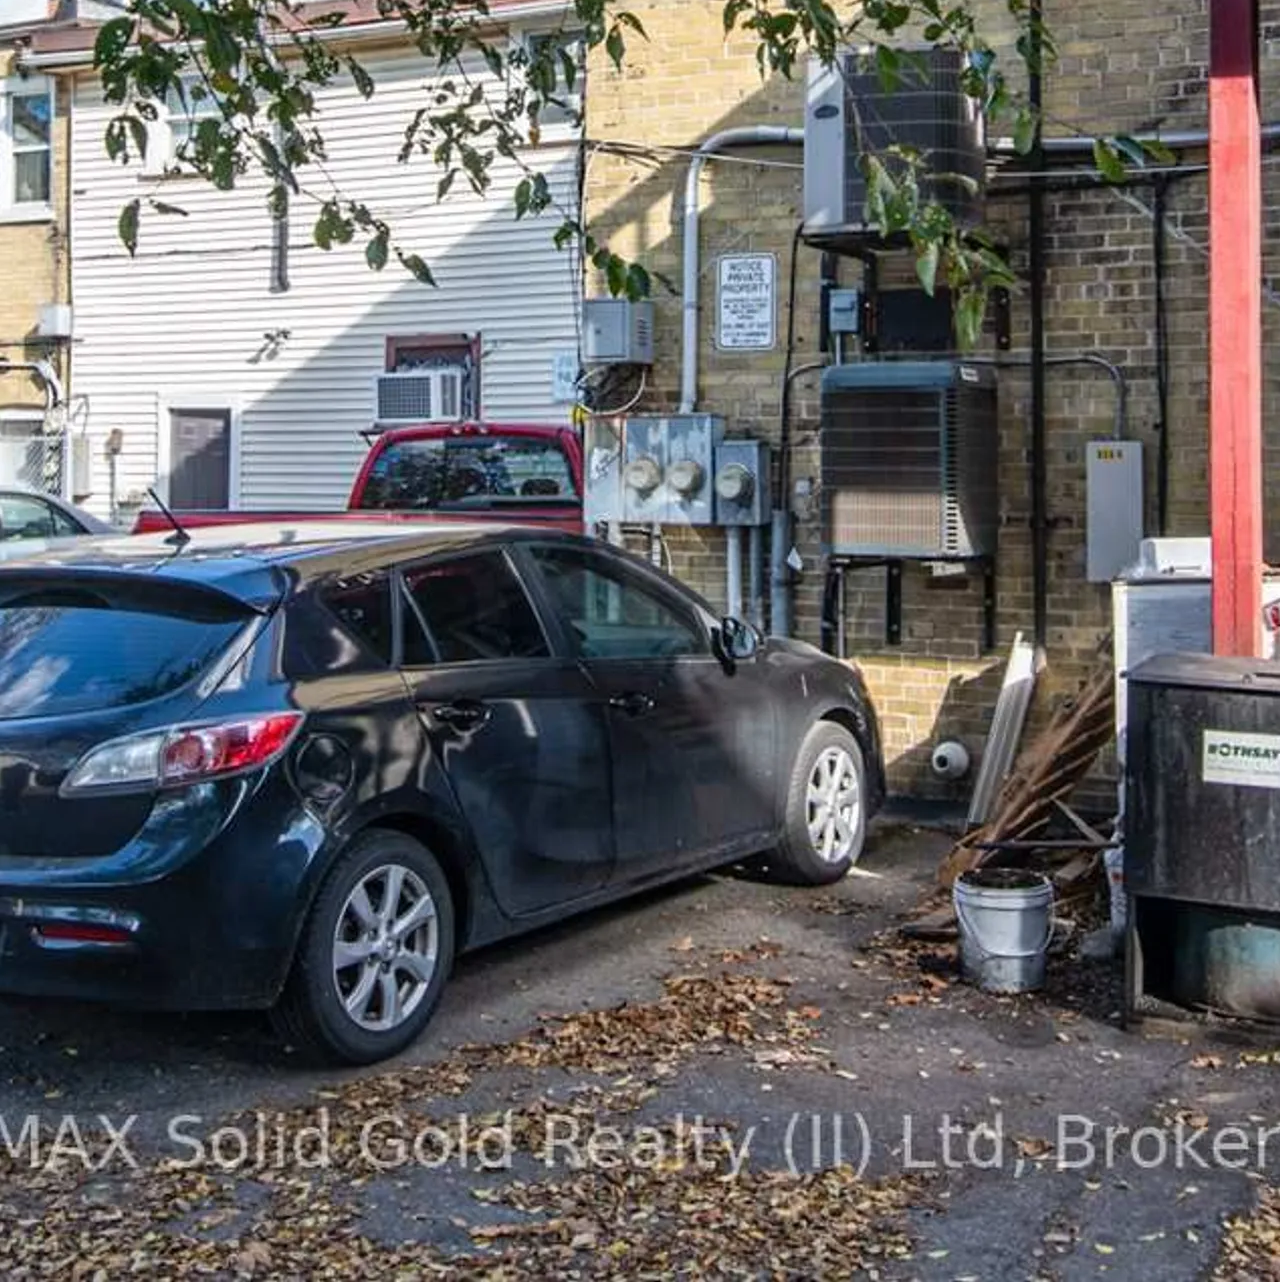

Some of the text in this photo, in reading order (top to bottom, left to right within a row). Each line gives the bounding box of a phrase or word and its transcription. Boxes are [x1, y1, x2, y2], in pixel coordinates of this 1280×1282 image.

[727, 273, 765, 282] PRIVATE
[722, 284, 770, 294] PROPERTY
[1207, 742, 1280, 759] ROTHSAY
